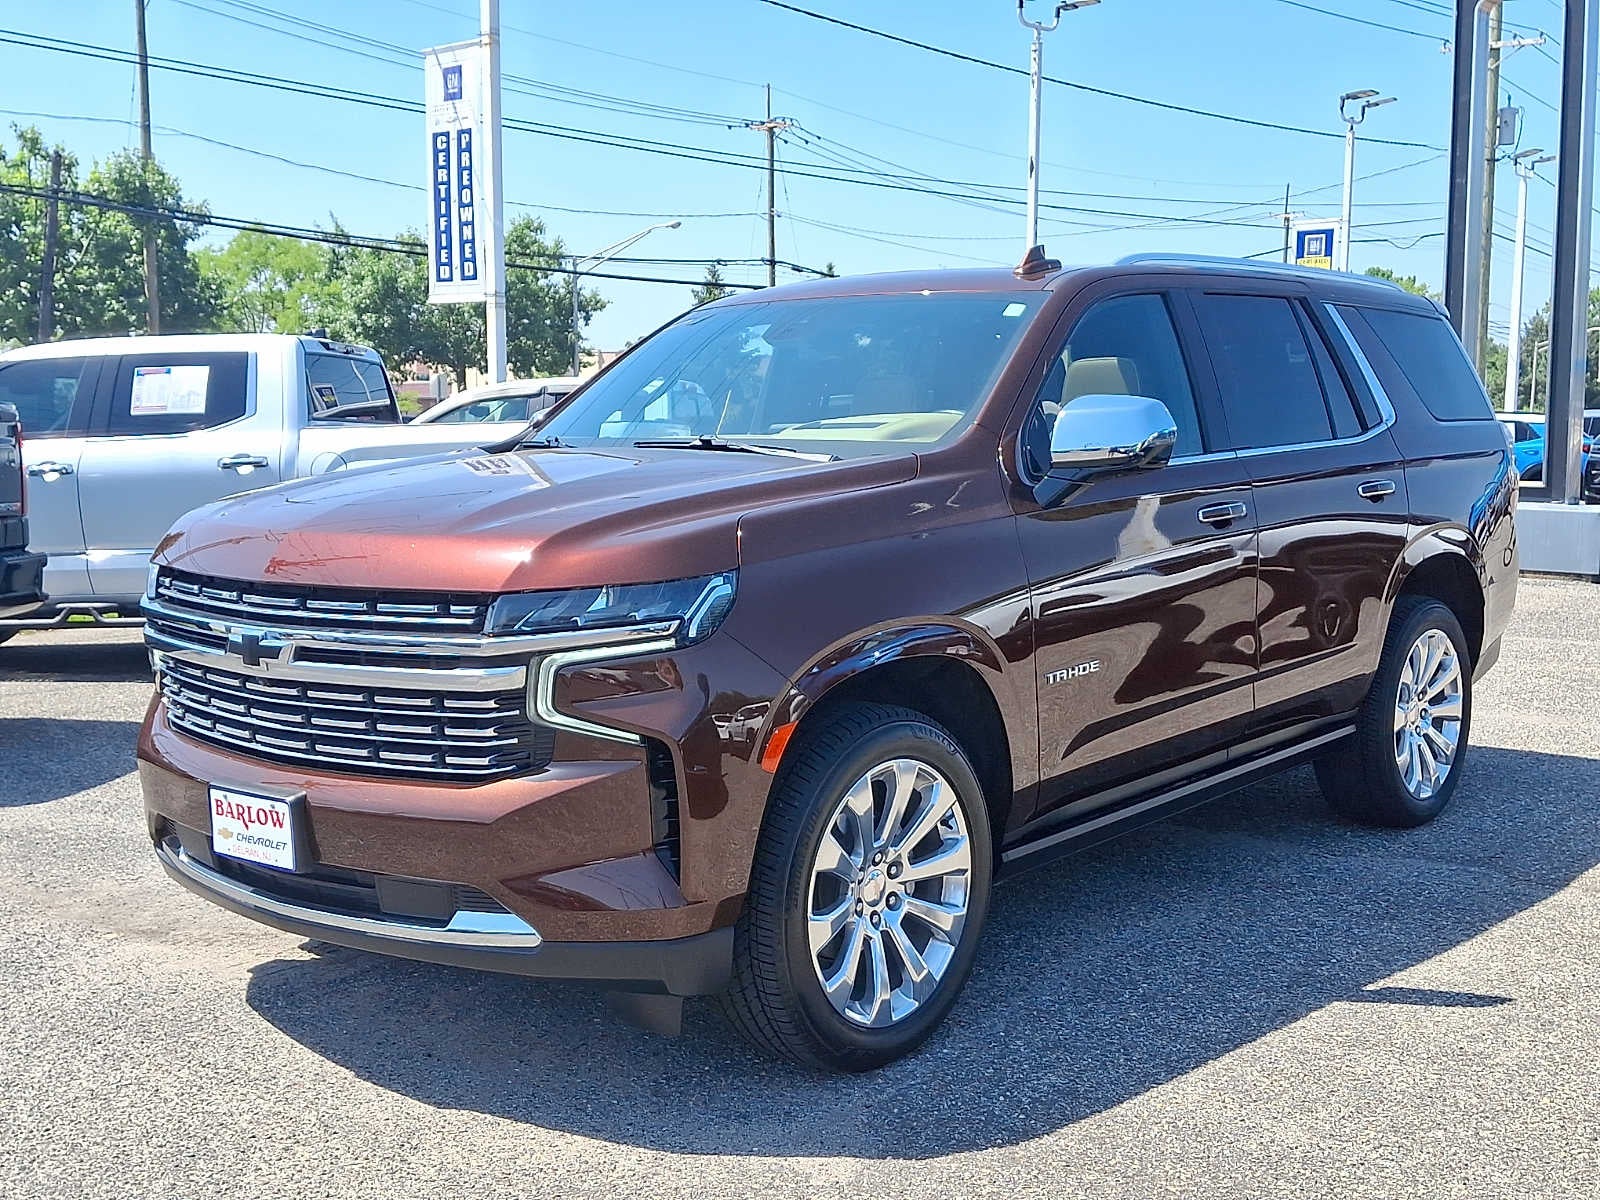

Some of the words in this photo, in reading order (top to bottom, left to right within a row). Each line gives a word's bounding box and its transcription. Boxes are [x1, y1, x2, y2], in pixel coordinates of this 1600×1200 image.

[446, 73, 458, 89] GM
[436, 135, 450, 279] CERTIFIED
[459, 133, 474, 277] PREOWNED
[1045, 660, 1100, 684] TAHOE
[214, 798, 285, 830] BARLOW
[236, 833, 287, 851] CHEVROLET
